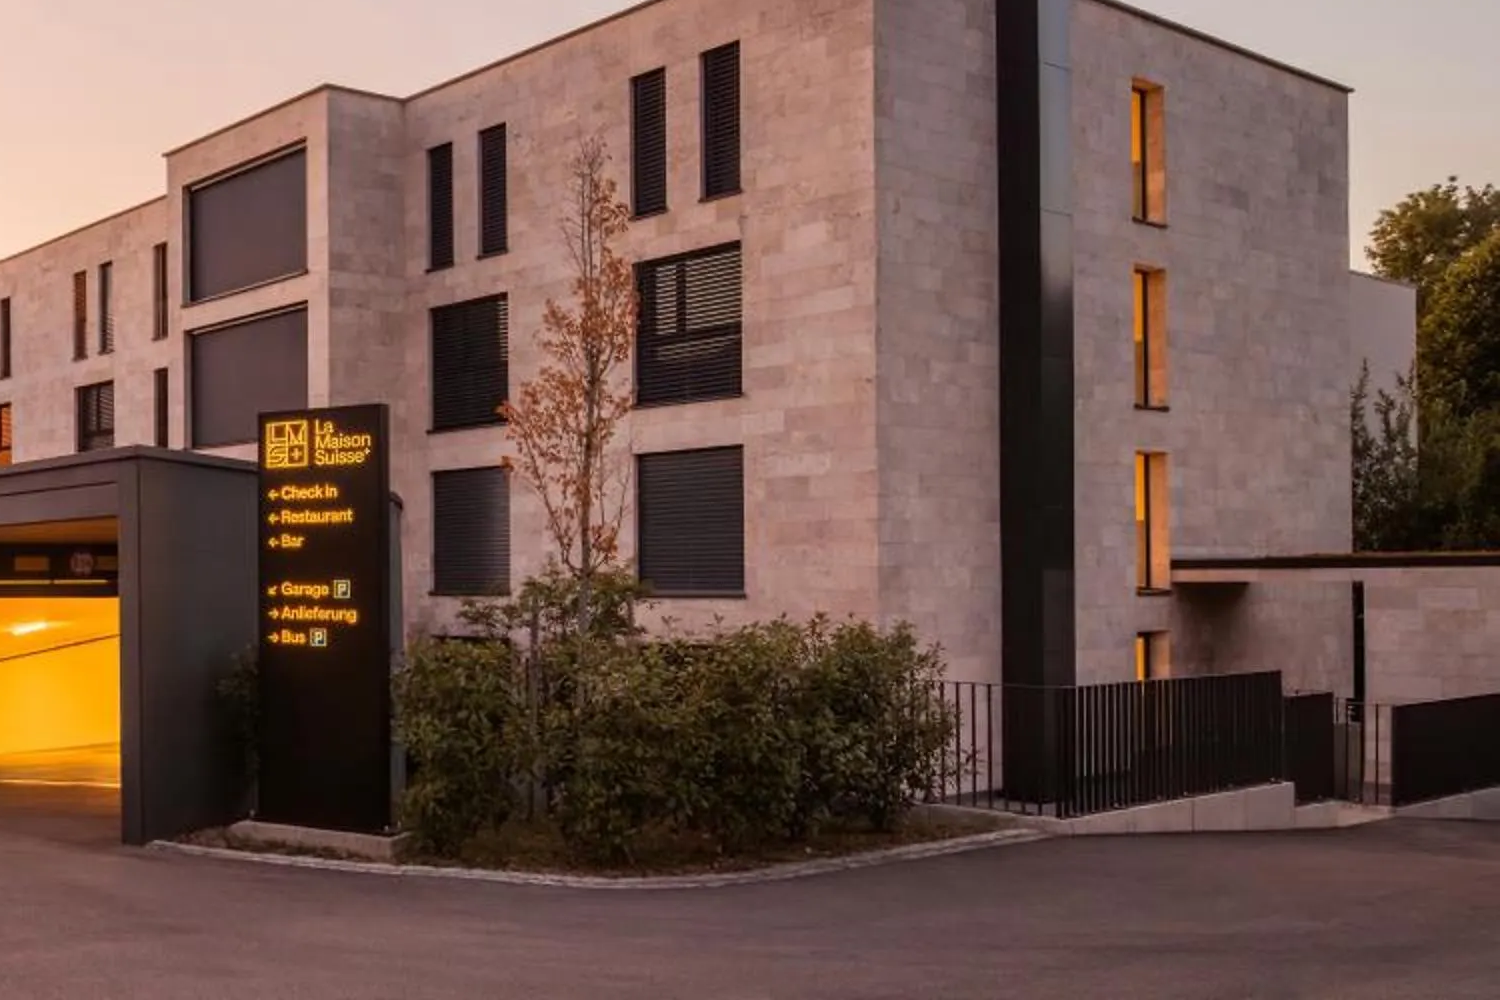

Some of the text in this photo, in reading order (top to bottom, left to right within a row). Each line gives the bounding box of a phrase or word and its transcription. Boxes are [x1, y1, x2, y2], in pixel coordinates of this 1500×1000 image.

[315, 419, 334, 434] La
[315, 433, 371, 449] Maison
[281, 484, 323, 499] Check
[281, 508, 353, 523] Restaurant
[281, 534, 304, 547] Bar
[281, 581, 329, 598] Garage
[281, 605, 358, 624] Anlieferung
[281, 629, 306, 644] Bus
